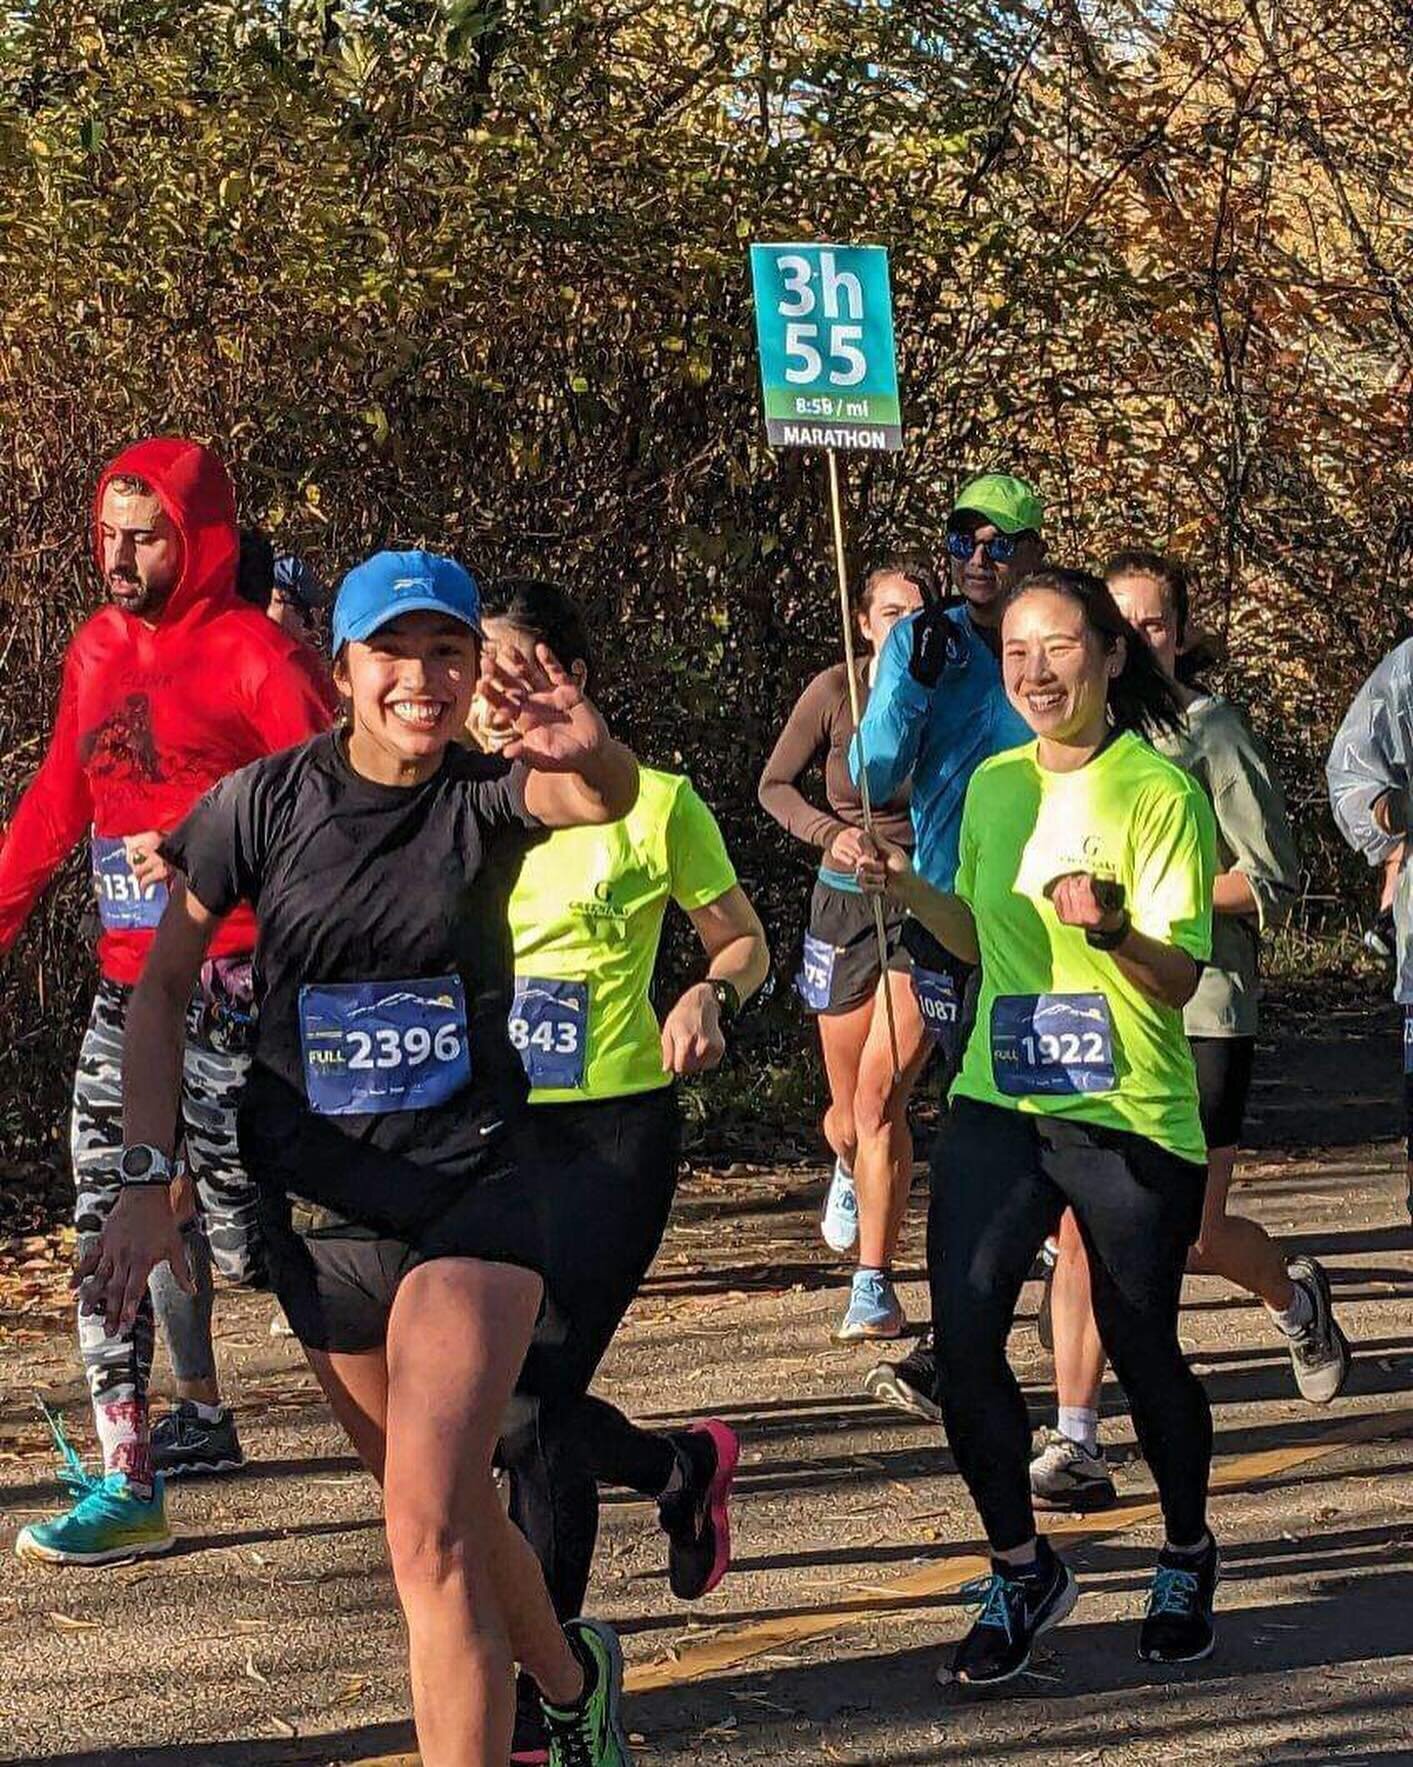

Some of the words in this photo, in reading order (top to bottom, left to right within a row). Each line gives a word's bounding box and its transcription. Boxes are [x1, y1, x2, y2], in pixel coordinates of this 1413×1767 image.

[776, 252, 864, 319] 3h
[784, 323, 867, 386] 55
[796, 397, 833, 415] 8:58
[846, 400, 868, 417] mi
[783, 426, 885, 449] MARATHON
[308, 1049, 347, 1065] FULL
[346, 1023, 461, 1070] 2396
[1021, 1031, 1105, 1065] 1922
